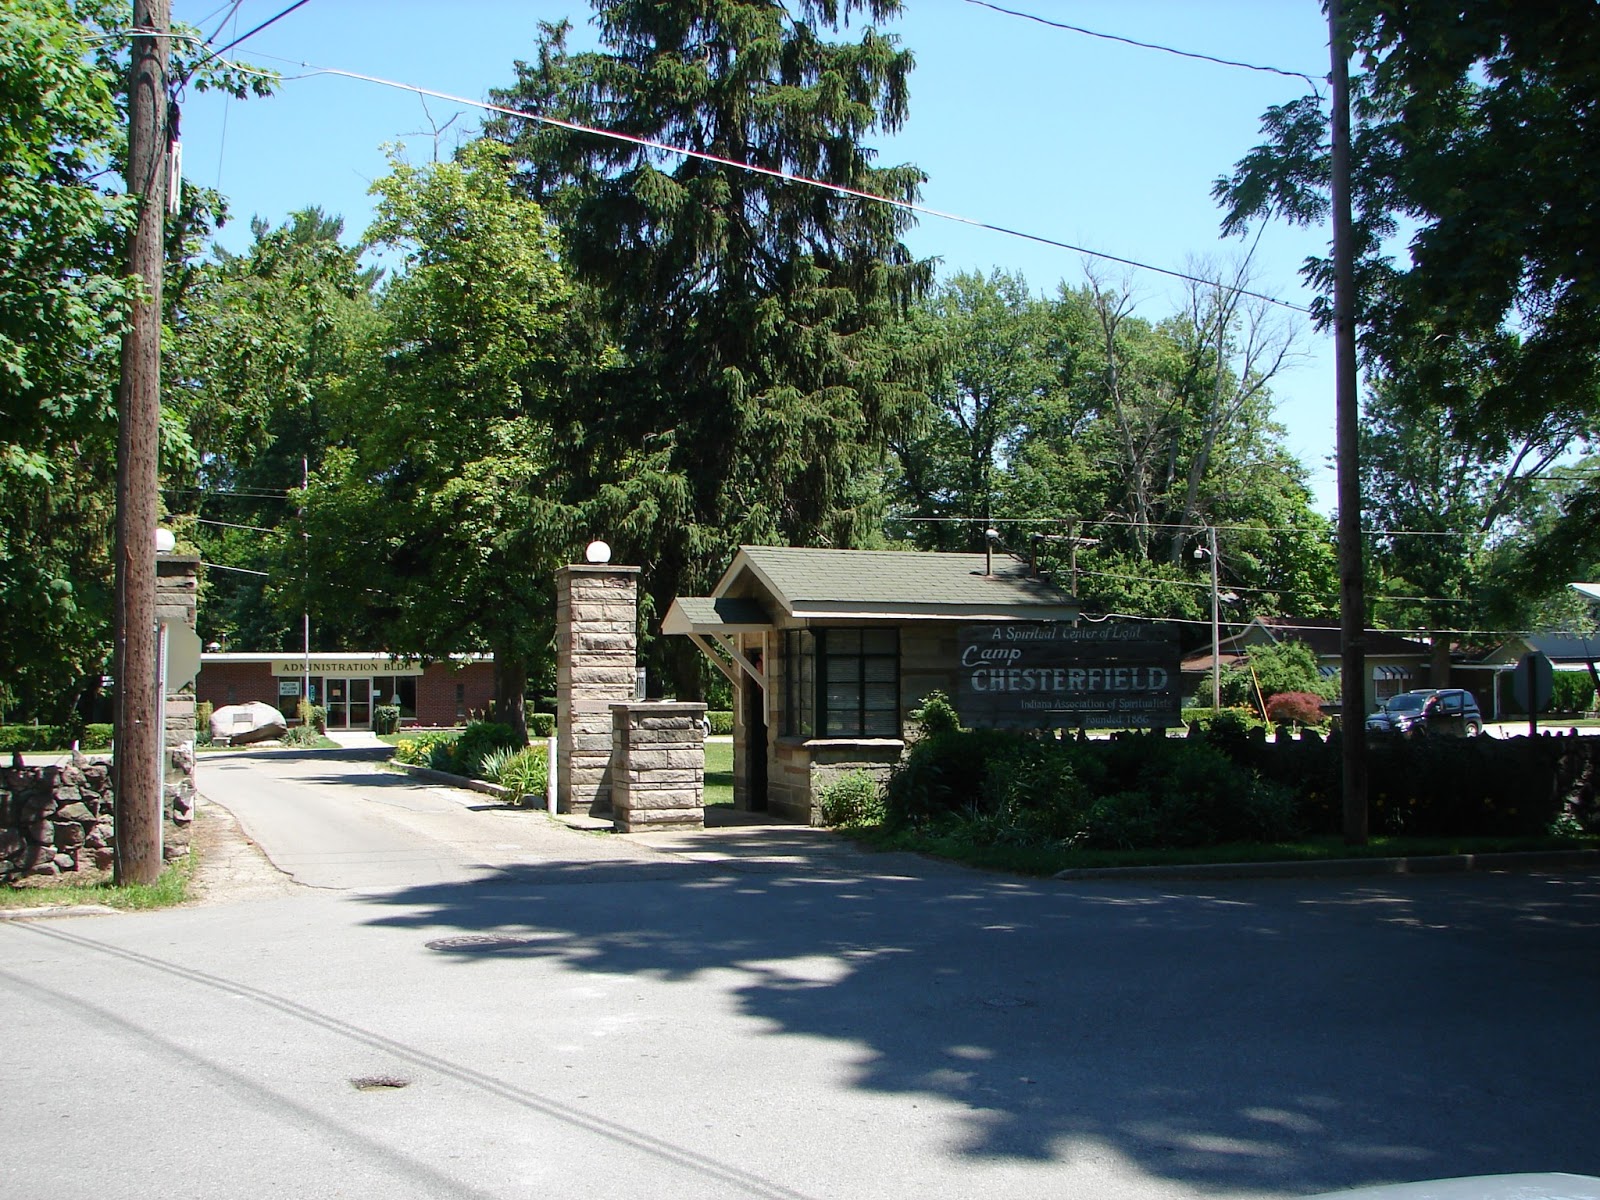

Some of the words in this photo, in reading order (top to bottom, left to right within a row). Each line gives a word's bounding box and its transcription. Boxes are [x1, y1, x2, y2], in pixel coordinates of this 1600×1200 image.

[992, 627, 1001, 640] A
[1006, 626, 1056, 641] Spiritual
[1062, 628, 1097, 639] Center
[1099, 626, 1111, 641] of
[1112, 626, 1141, 640] Light
[961, 645, 1022, 667] Camp
[283, 663, 378, 672] ADMINISTRATION
[971, 667, 1168, 692] CHESTERFIELD
[1021, 700, 1052, 709] Indiana
[1054, 699, 1104, 709] Association
[1106, 699, 1117, 710] of
[1085, 714, 1122, 725] Founded
